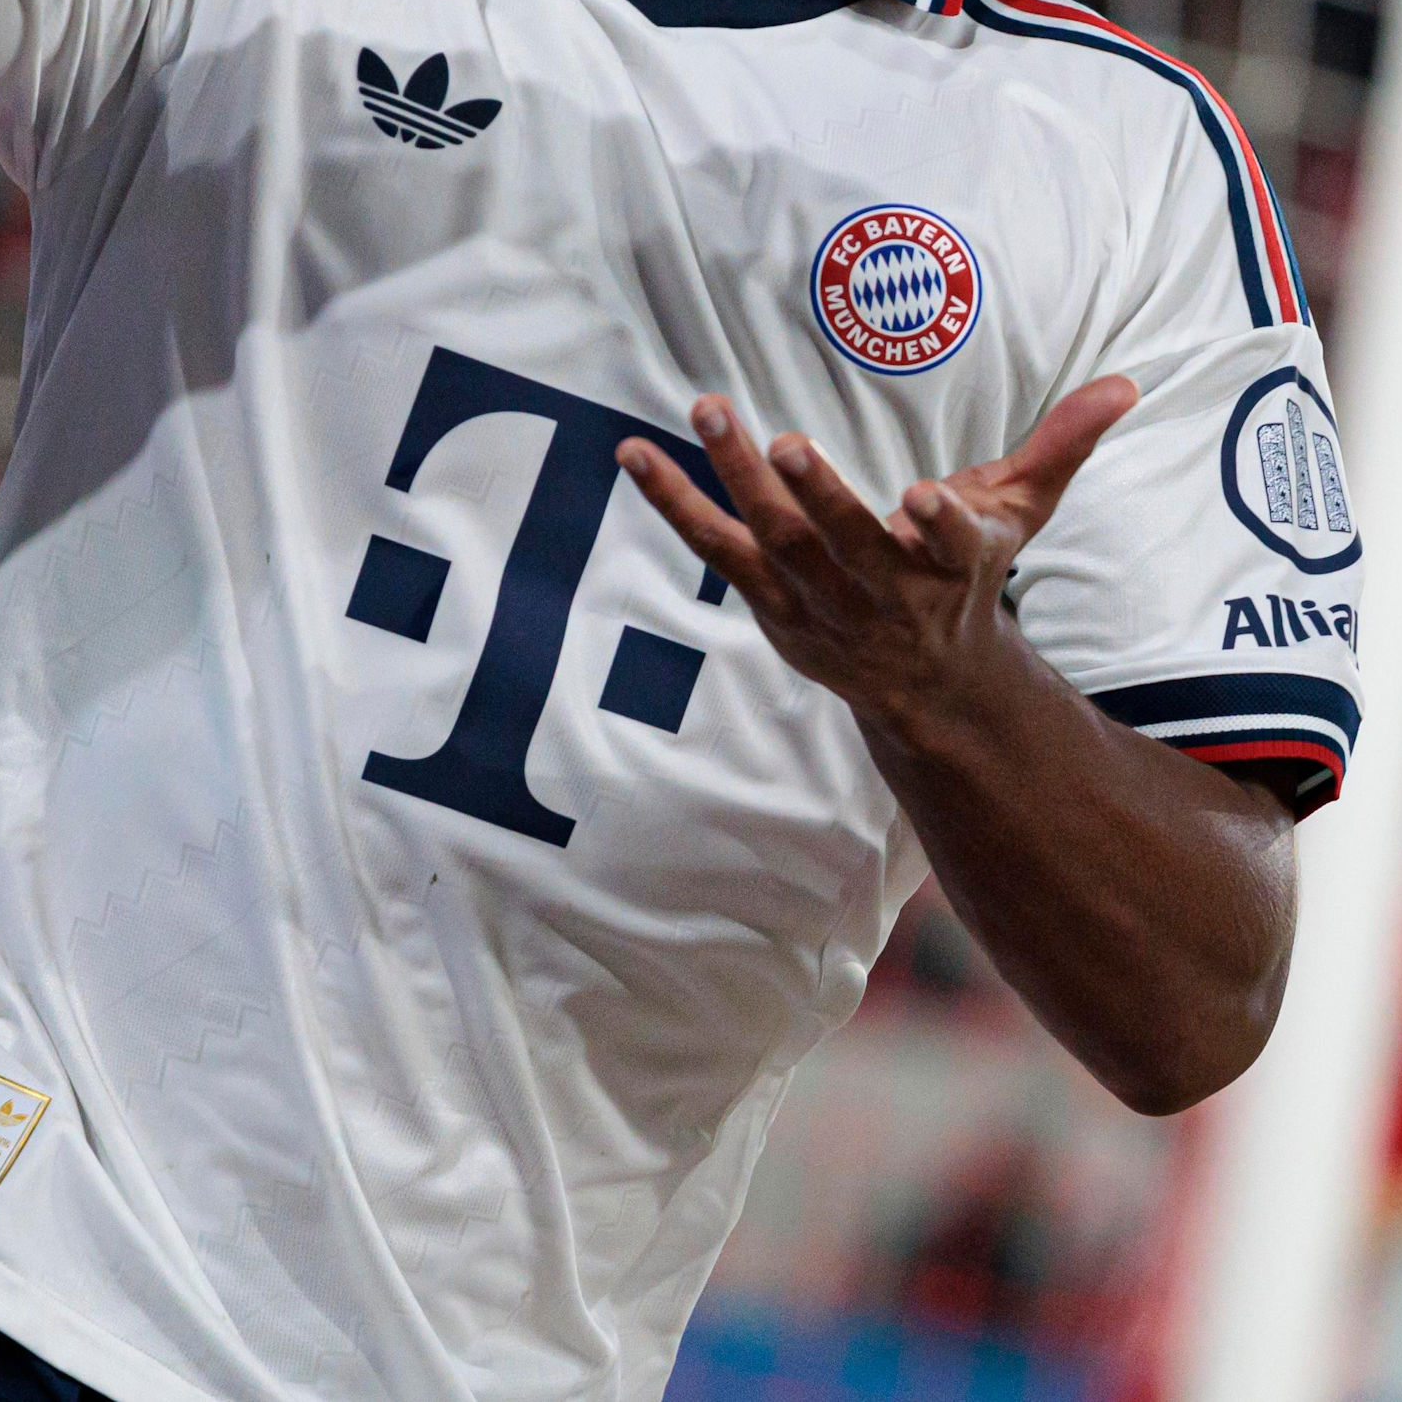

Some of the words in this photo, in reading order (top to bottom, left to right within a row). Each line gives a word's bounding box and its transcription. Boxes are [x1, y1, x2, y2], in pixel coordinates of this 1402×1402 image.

[831, 233, 862, 267] FC
[863, 216, 967, 276] BAYERN
[939, 295, 969, 335] EV
[1221, 593, 1359, 655] Allia
